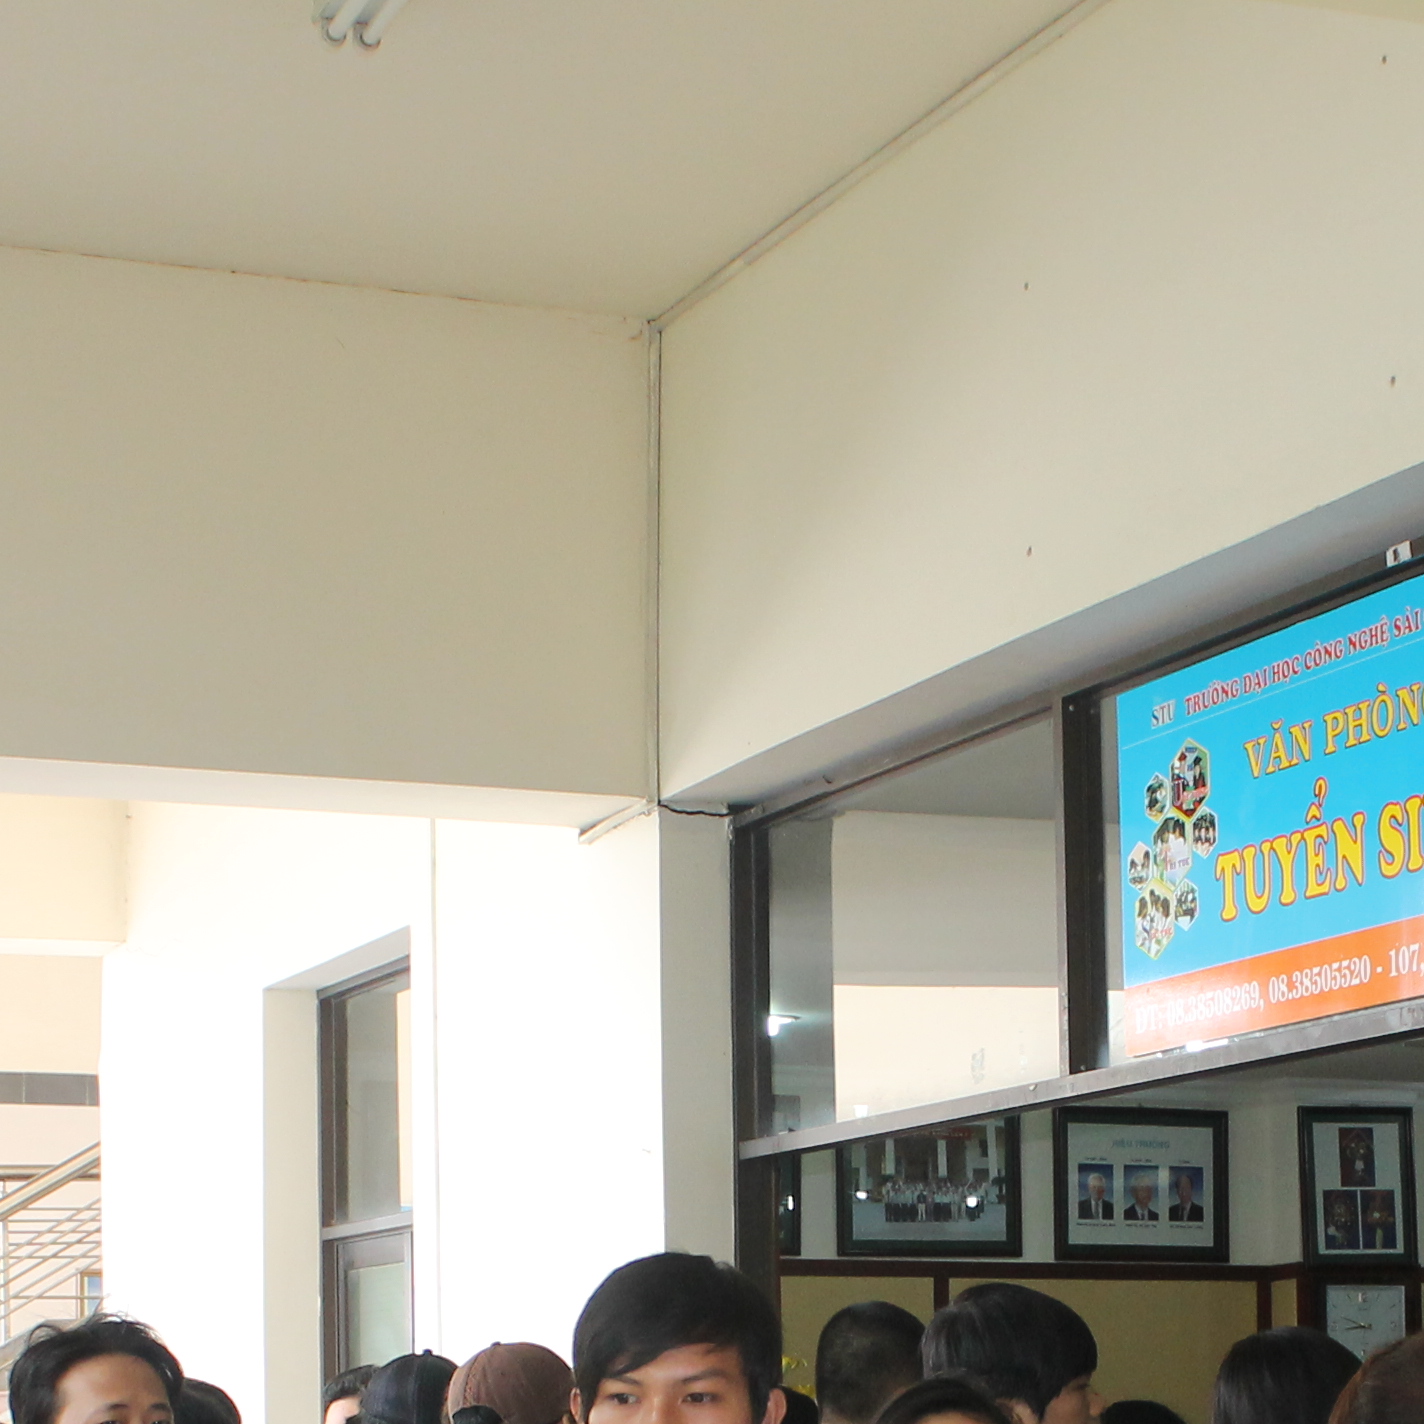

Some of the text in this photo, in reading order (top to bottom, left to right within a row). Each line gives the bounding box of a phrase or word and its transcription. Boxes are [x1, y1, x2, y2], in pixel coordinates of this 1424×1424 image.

[1242, 666, 1269, 694] ĐẠI
[1270, 655, 1302, 684] HỌC
[1303, 640, 1344, 671] CÔNG
[1346, 614, 1390, 656] NGHỆ
[1392, 606, 1422, 638] SÀI
[1243, 718, 1313, 779] VĂN
[1215, 776, 1367, 922] TUYỂN
[1269, 954, 1371, 1004] 08.38505520
